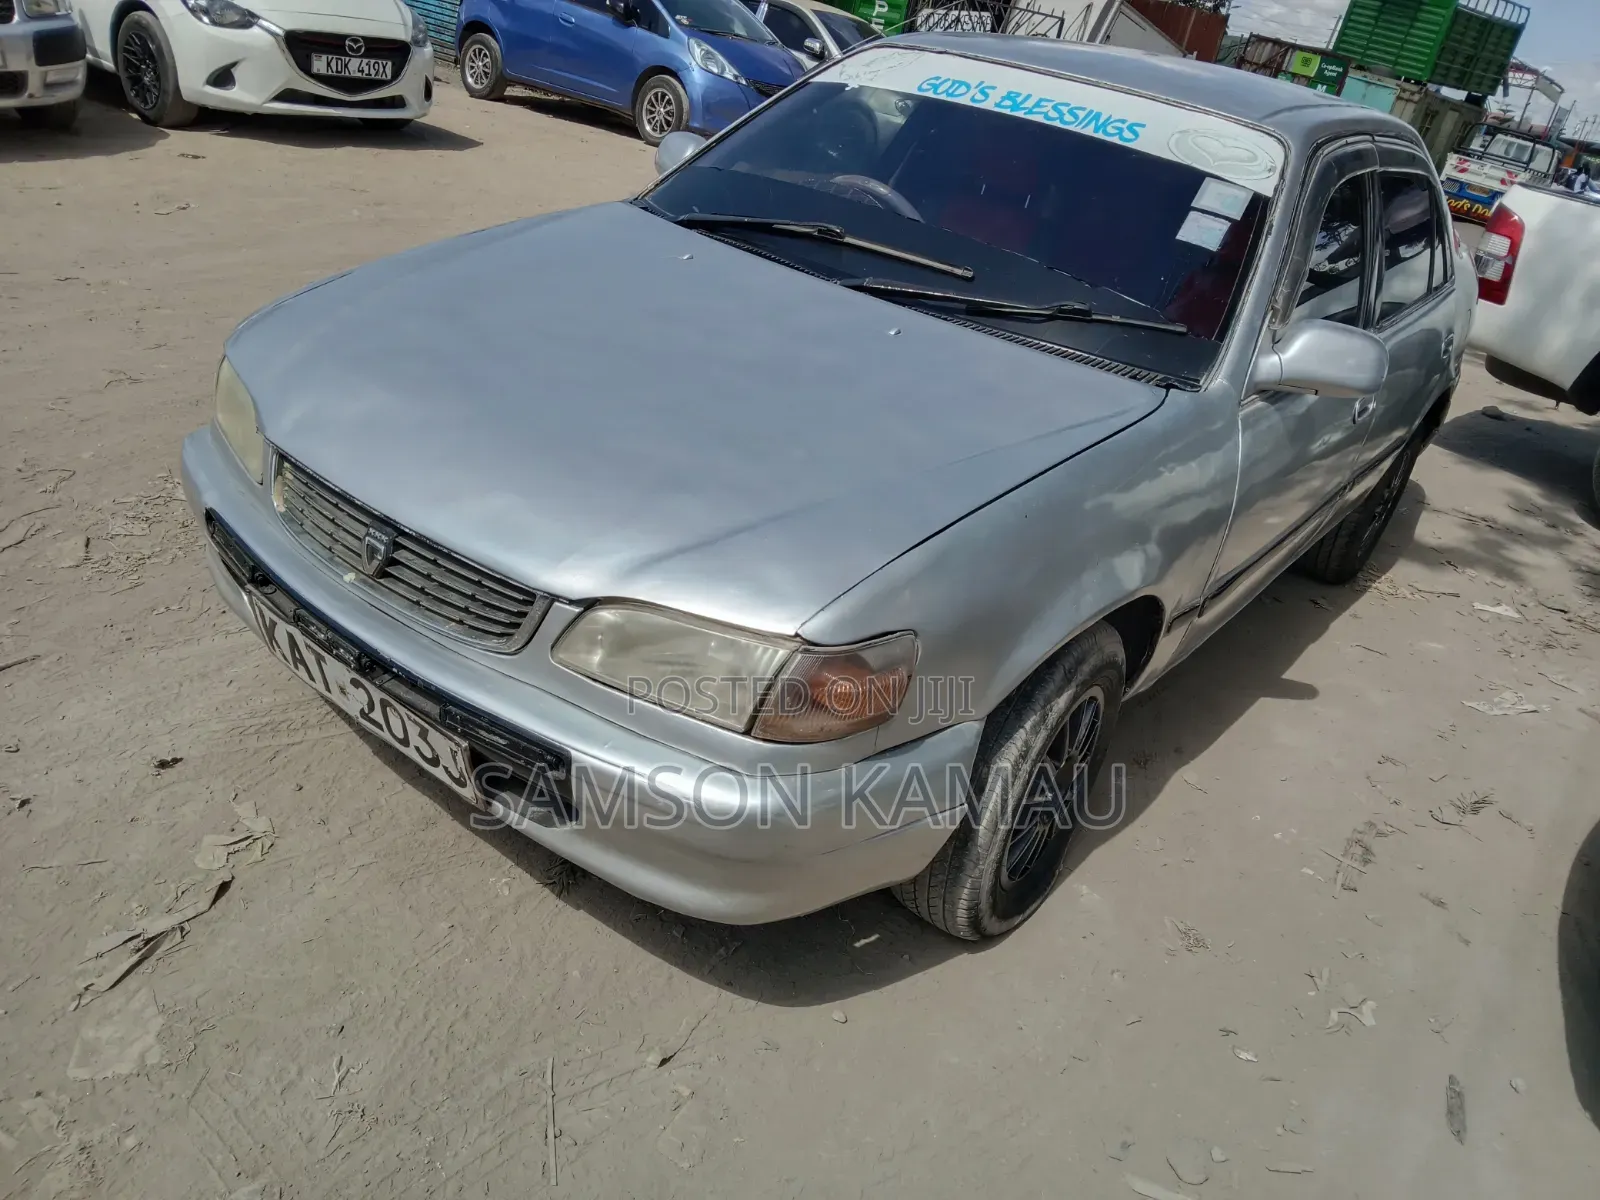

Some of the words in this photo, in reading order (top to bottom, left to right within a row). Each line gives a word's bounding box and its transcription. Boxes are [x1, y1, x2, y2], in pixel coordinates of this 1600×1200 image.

[326, 55, 352, 76] KDK
[357, 59, 389, 79] 419X
[917, 76, 997, 104] GOD'S
[994, 90, 1146, 143] BLESSINGS
[254, 597, 332, 694] KAT
